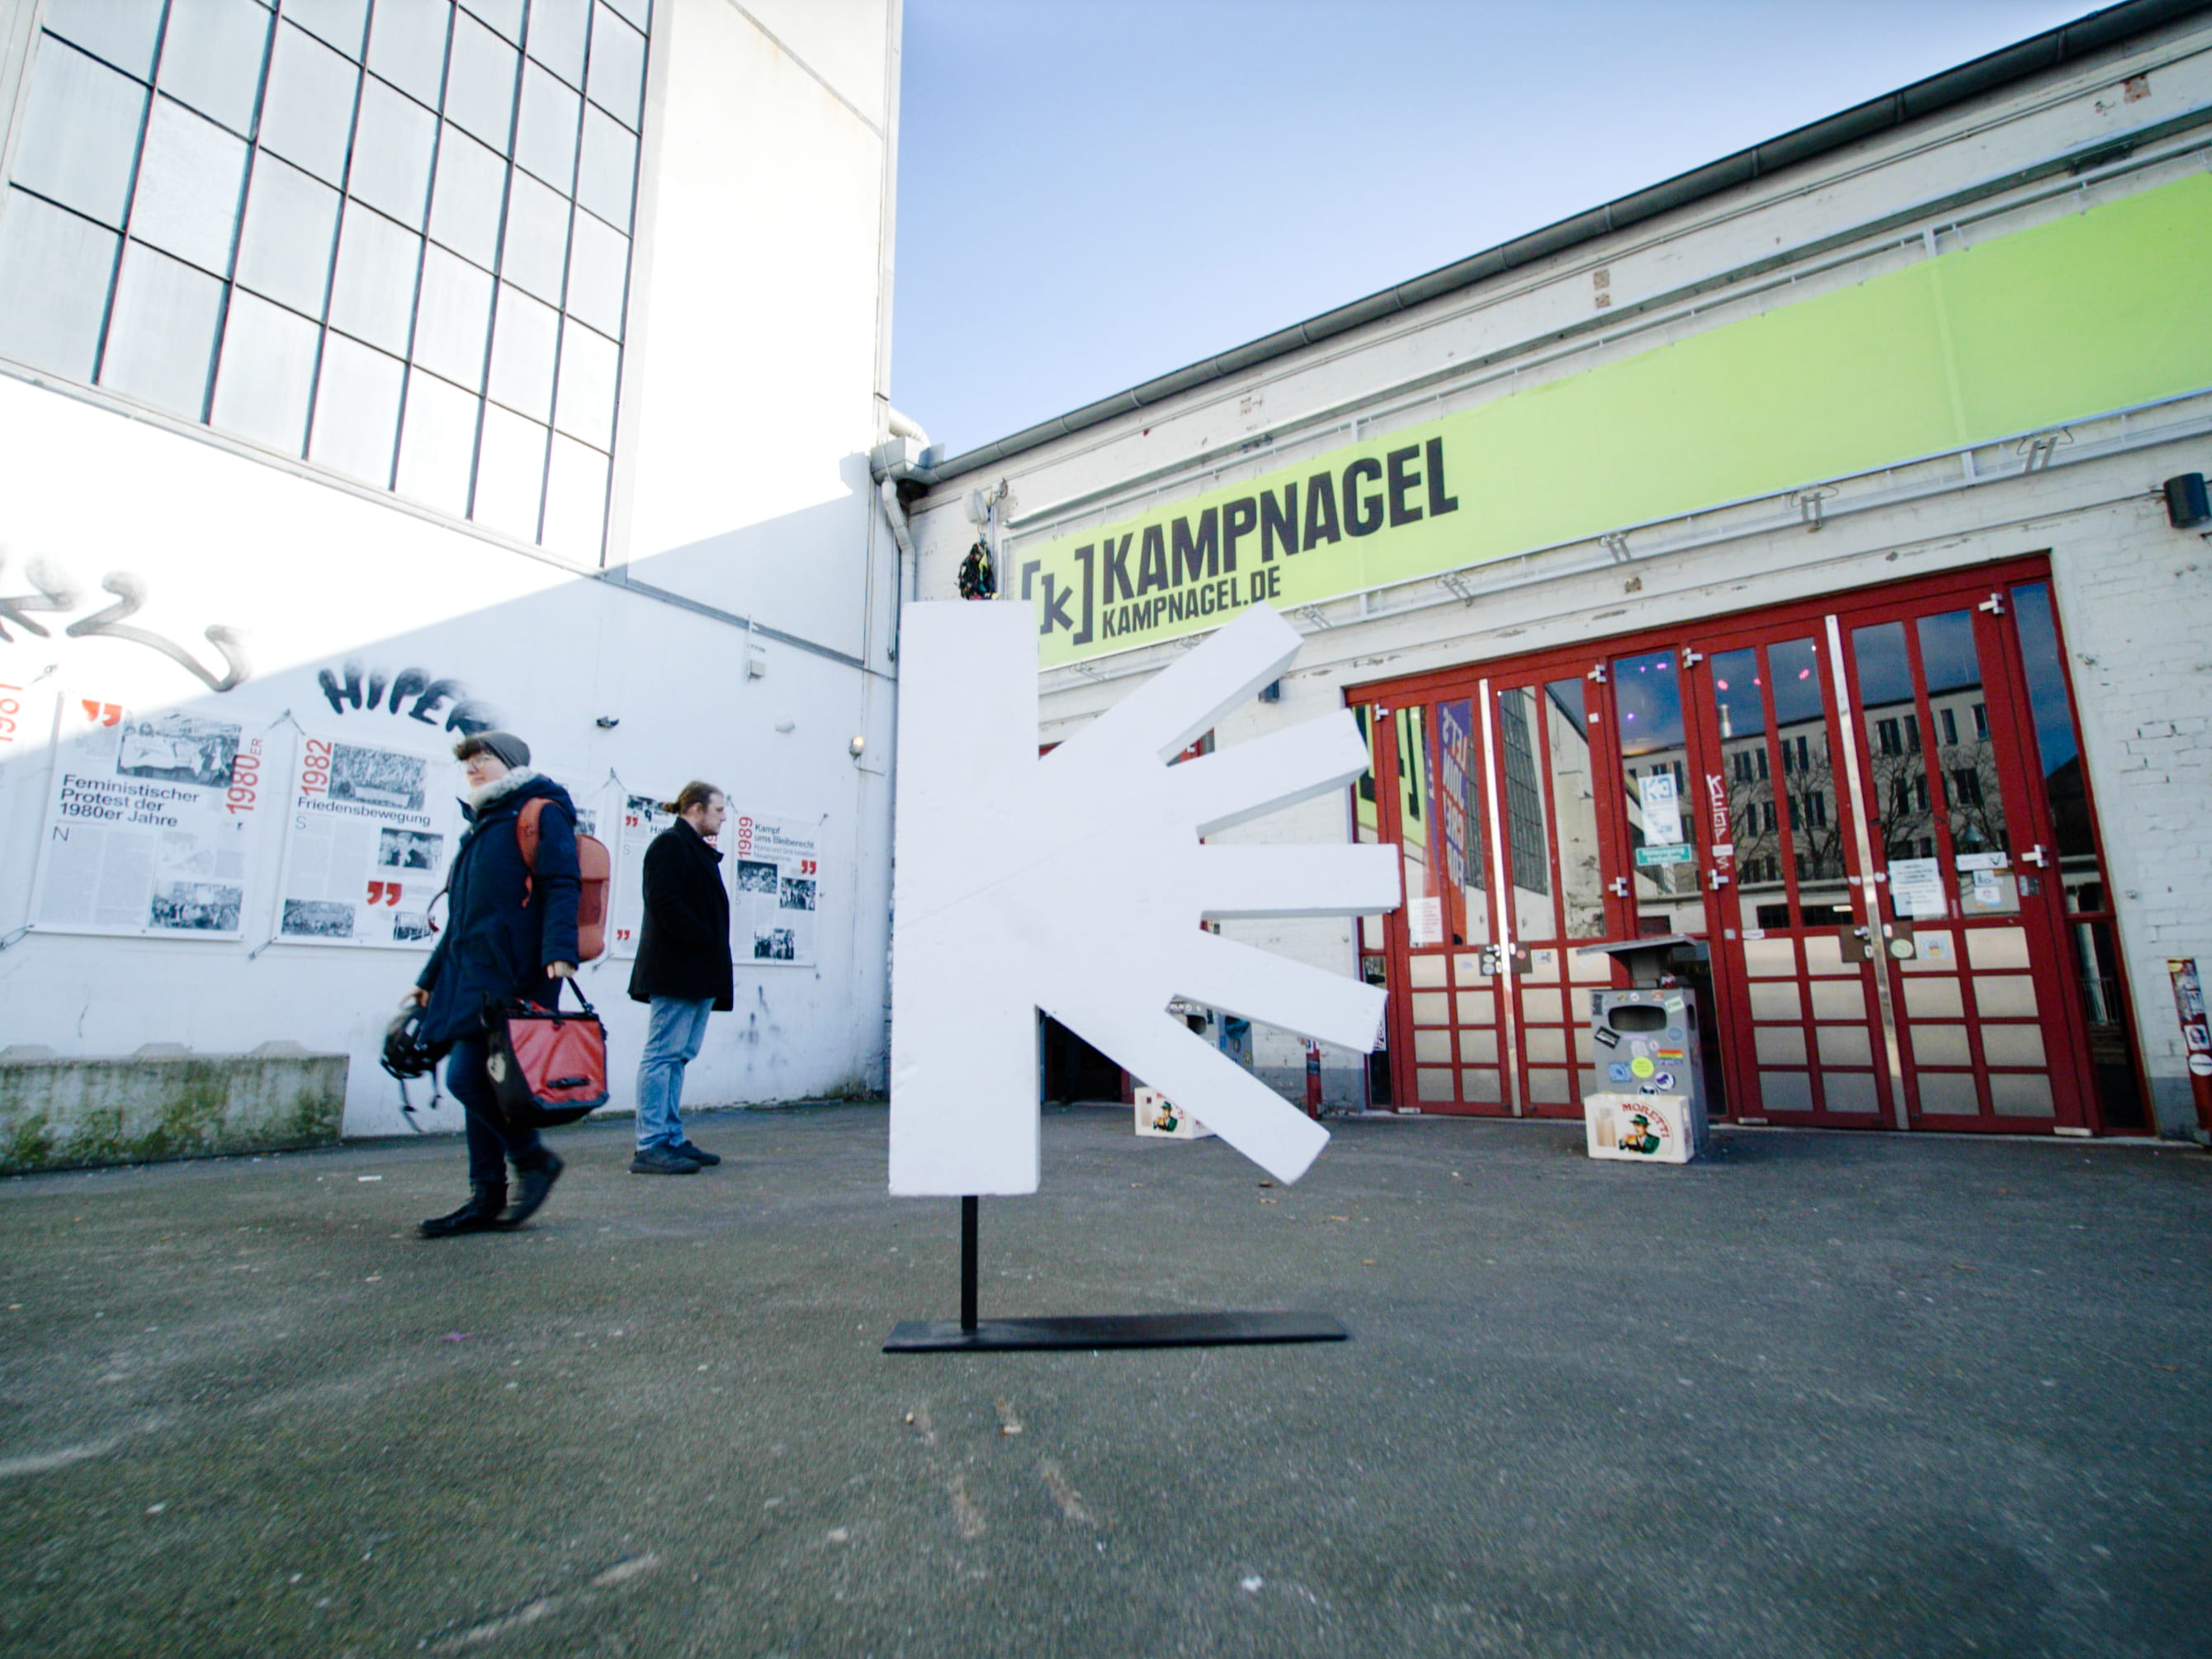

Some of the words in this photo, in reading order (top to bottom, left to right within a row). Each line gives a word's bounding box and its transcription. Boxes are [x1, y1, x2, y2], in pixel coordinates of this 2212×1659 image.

[1103, 436, 1459, 605] KAMPNAGEL
[1102, 565, 1282, 640] KAMPNAGEL.DE
[301, 739, 333, 796] 1982
[60, 788, 131, 807] Protest
[134, 797, 166, 812] der
[62, 774, 201, 803] Feministischer
[59, 802, 124, 821] 1980er
[127, 811, 178, 827] Jahre
[297, 796, 432, 826] Friedensbewegung
[738, 816, 753, 858] 1989
[1621, 1102, 1671, 1139] MORETTI
